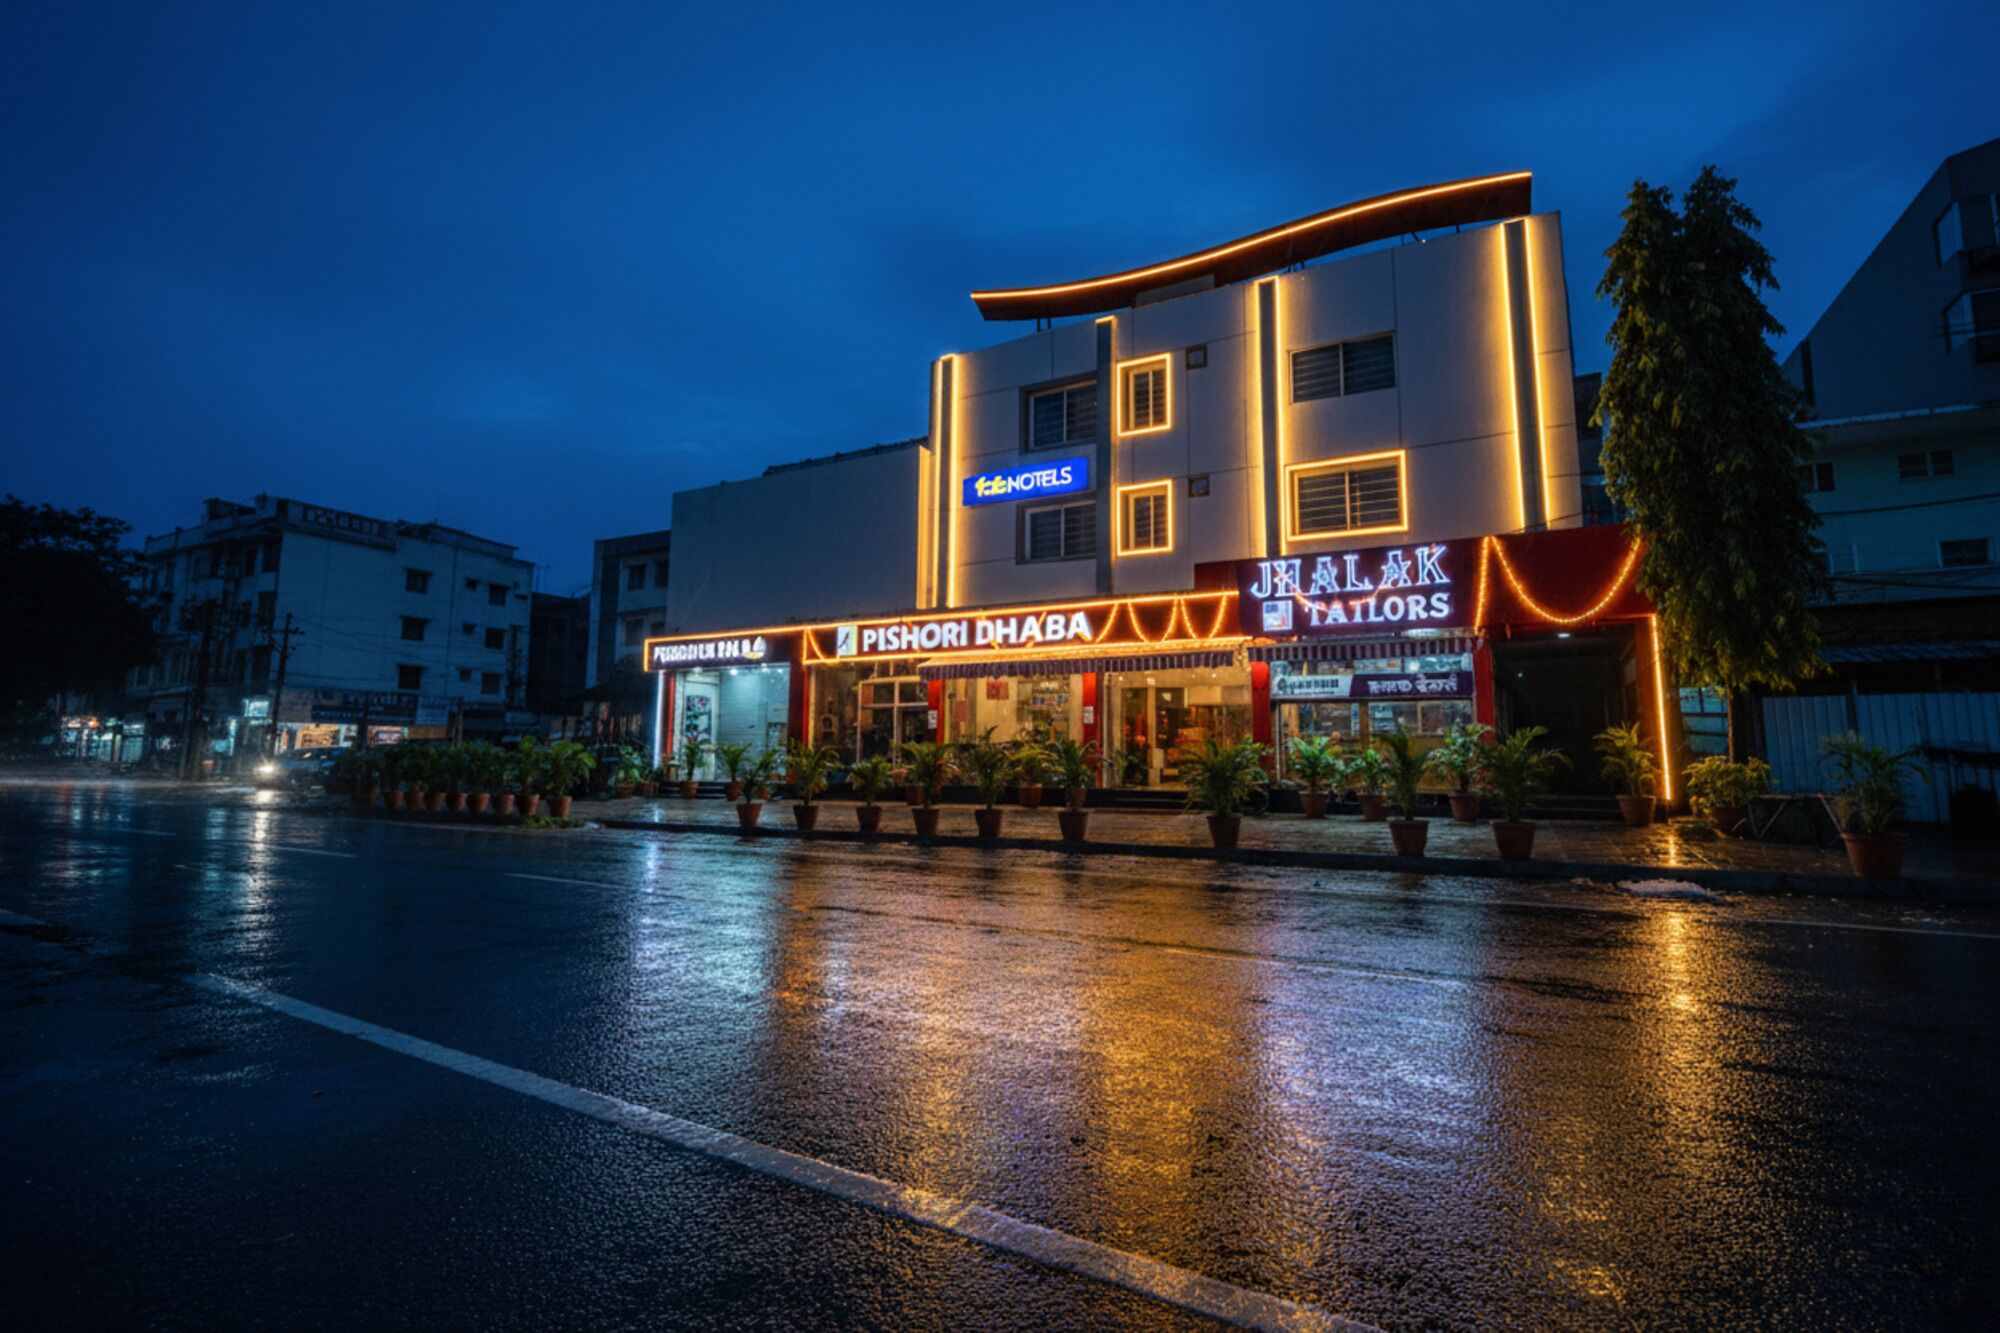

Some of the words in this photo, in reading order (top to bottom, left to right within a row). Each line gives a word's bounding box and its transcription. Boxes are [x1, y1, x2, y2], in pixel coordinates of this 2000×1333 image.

[1250, 546, 1450, 598] JHALAK
[1304, 592, 1450, 626] TAILORS
[863, 620, 968, 652] PISHORI
[974, 612, 1092, 647] DHABA
